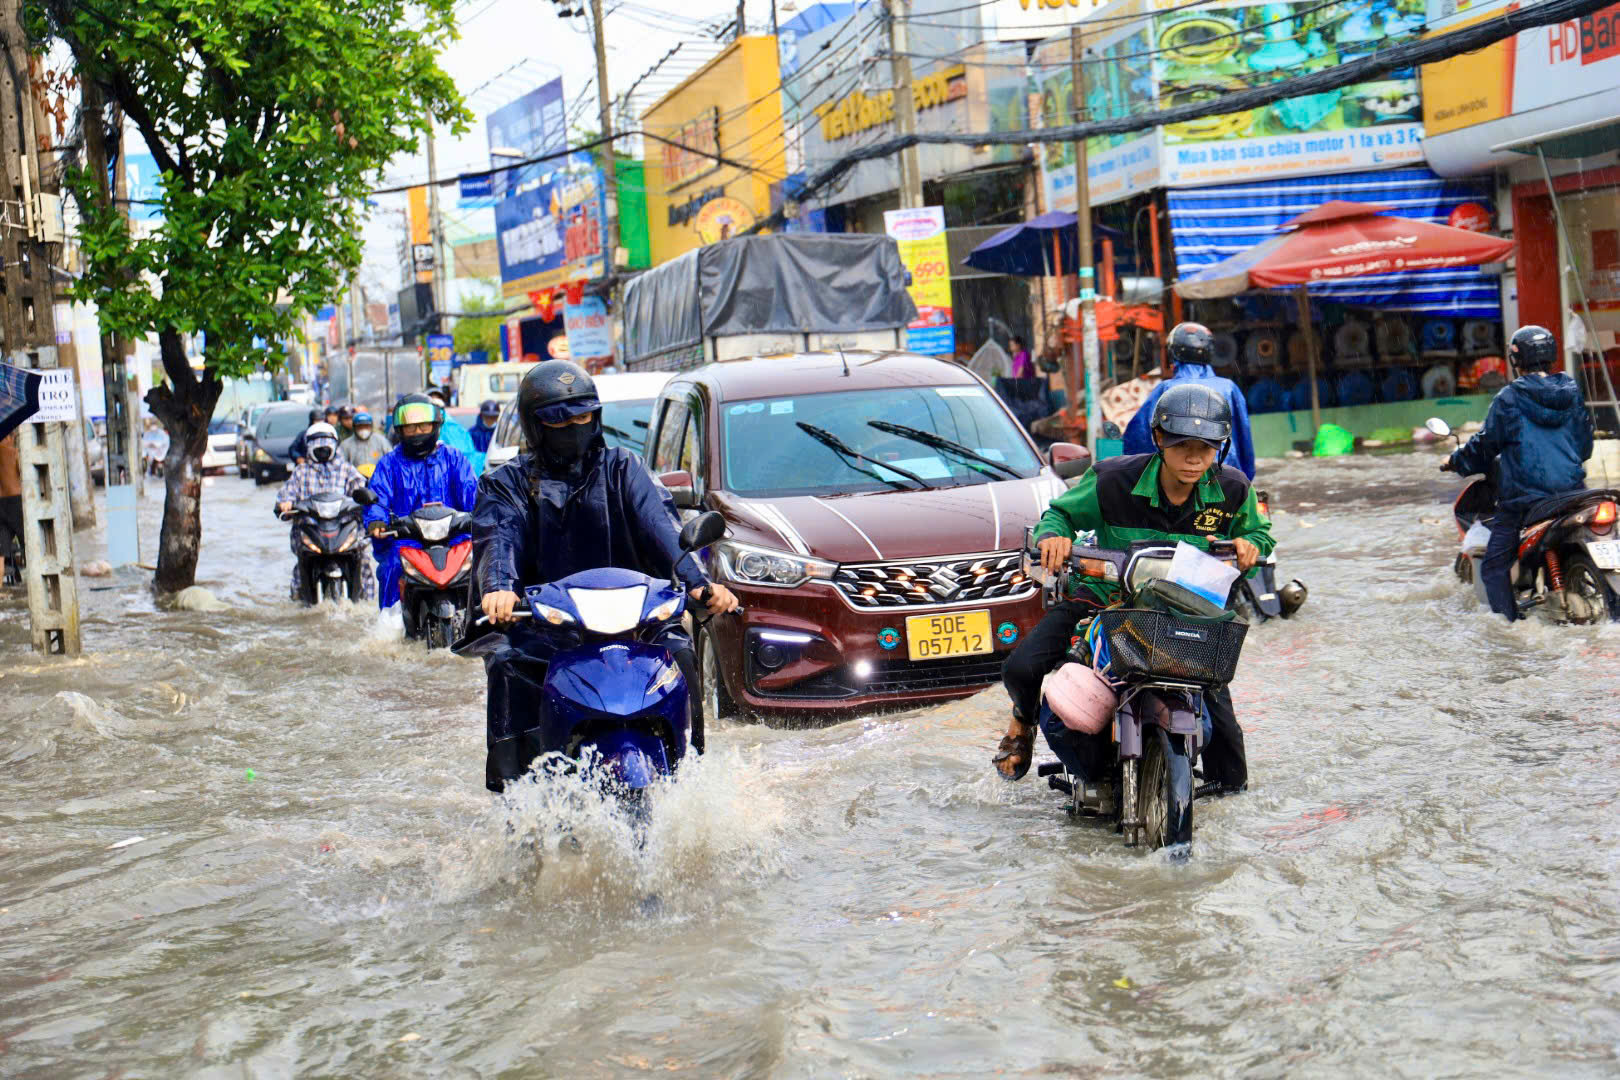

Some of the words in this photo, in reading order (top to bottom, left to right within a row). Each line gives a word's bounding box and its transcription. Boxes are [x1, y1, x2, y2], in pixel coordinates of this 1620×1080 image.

[1178, 149, 1207, 164] Mua
[1305, 138, 1344, 153] motor
[1396, 129, 1405, 144] 3
[931, 616, 966, 635] 50E
[1175, 630, 1201, 639] HONDA
[599, 644, 630, 652] HONDA
[918, 634, 983, 656] 057.12
